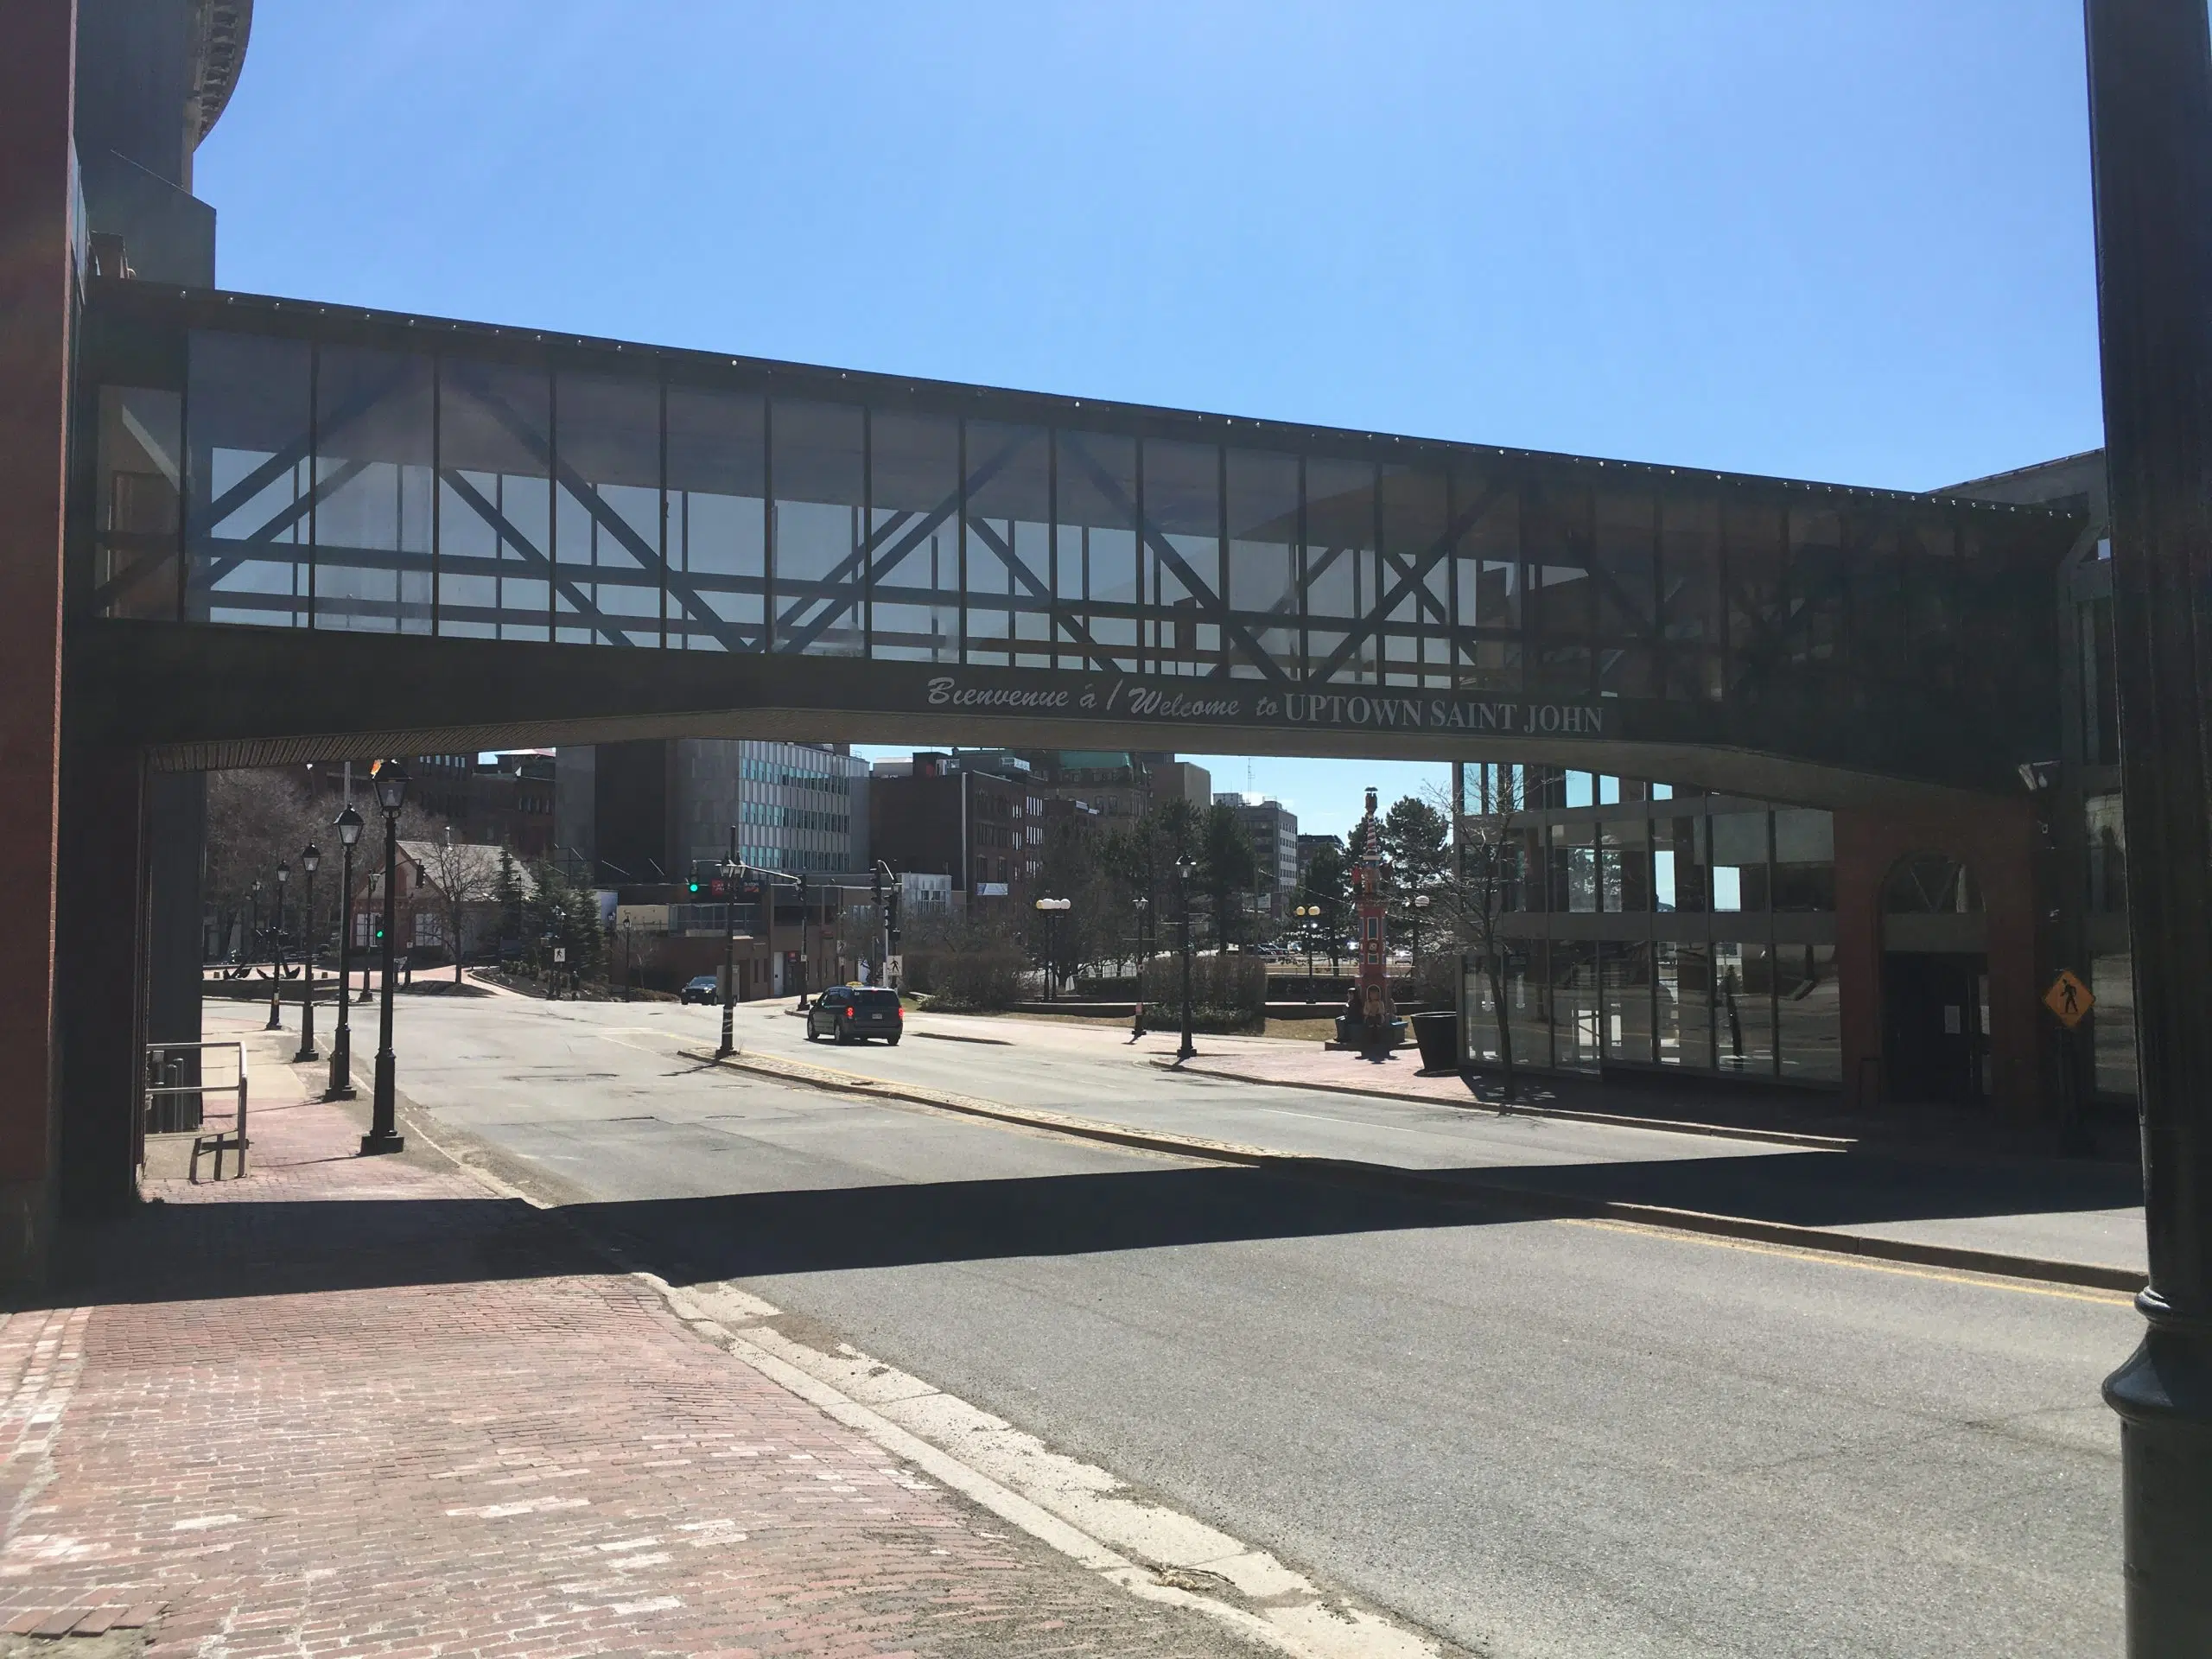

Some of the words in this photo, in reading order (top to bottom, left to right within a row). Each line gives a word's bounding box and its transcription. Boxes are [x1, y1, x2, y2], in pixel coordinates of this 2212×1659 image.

[927, 677, 1069, 708] Bienvenue
[1128, 687, 1240, 717] Welcome
[1255, 696, 1279, 716] to
[1284, 692, 1425, 727] UPTOWN
[1430, 697, 1518, 731] SAINT
[1523, 703, 1603, 734] JOHN
